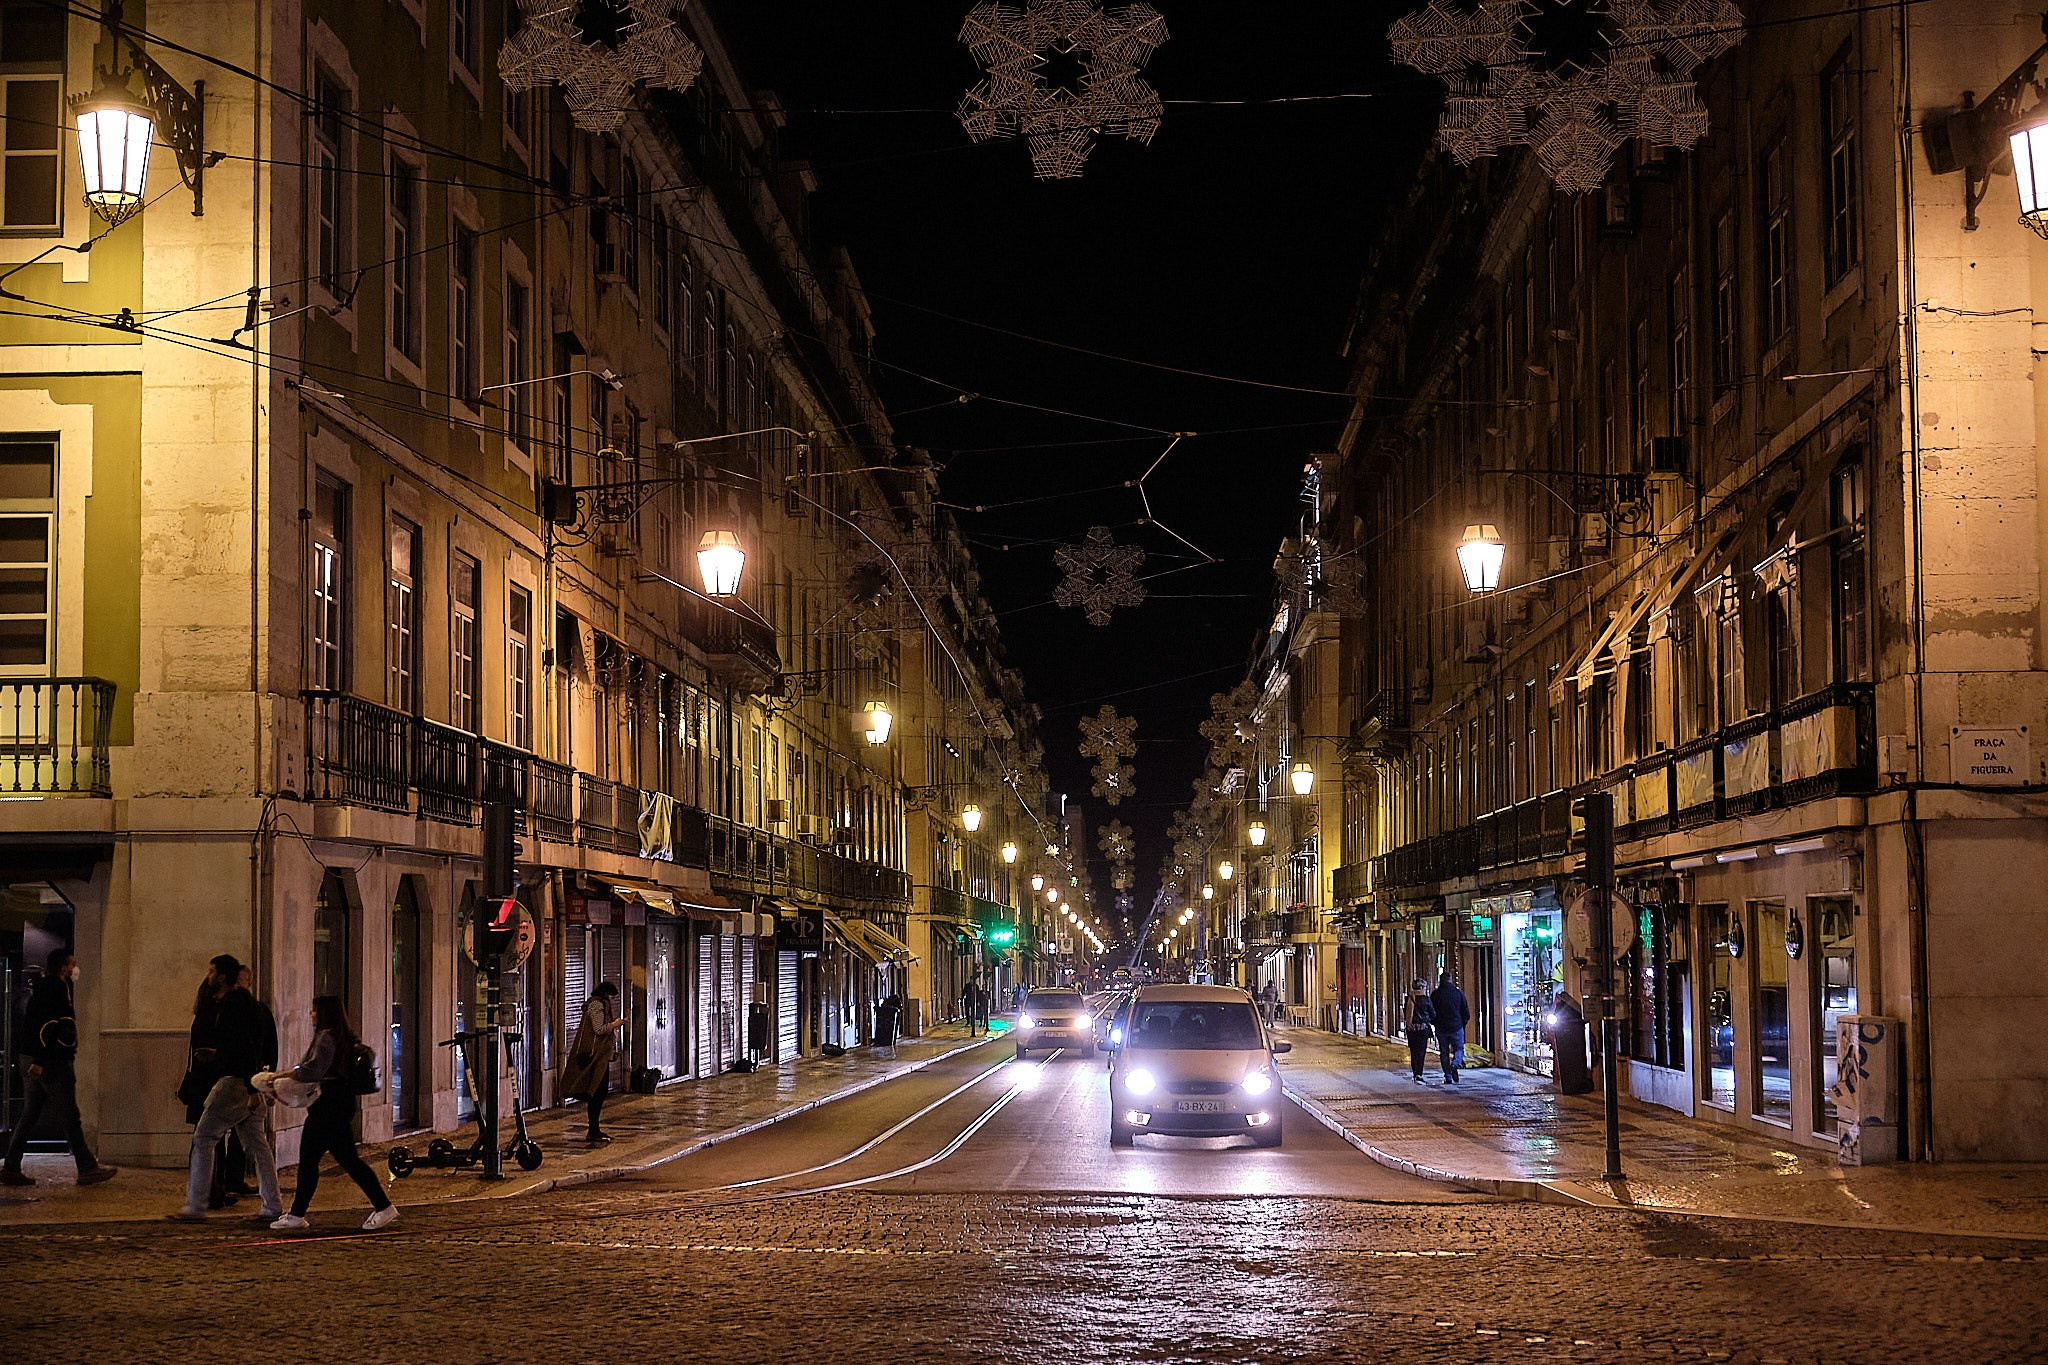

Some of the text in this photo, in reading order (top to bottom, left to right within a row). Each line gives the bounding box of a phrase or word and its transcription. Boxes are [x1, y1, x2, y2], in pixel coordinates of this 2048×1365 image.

[1974, 738, 2005, 747] PRAÇA
[1983, 752, 1997, 760] DA
[1971, 765, 2013, 774] FIGUEIRA
